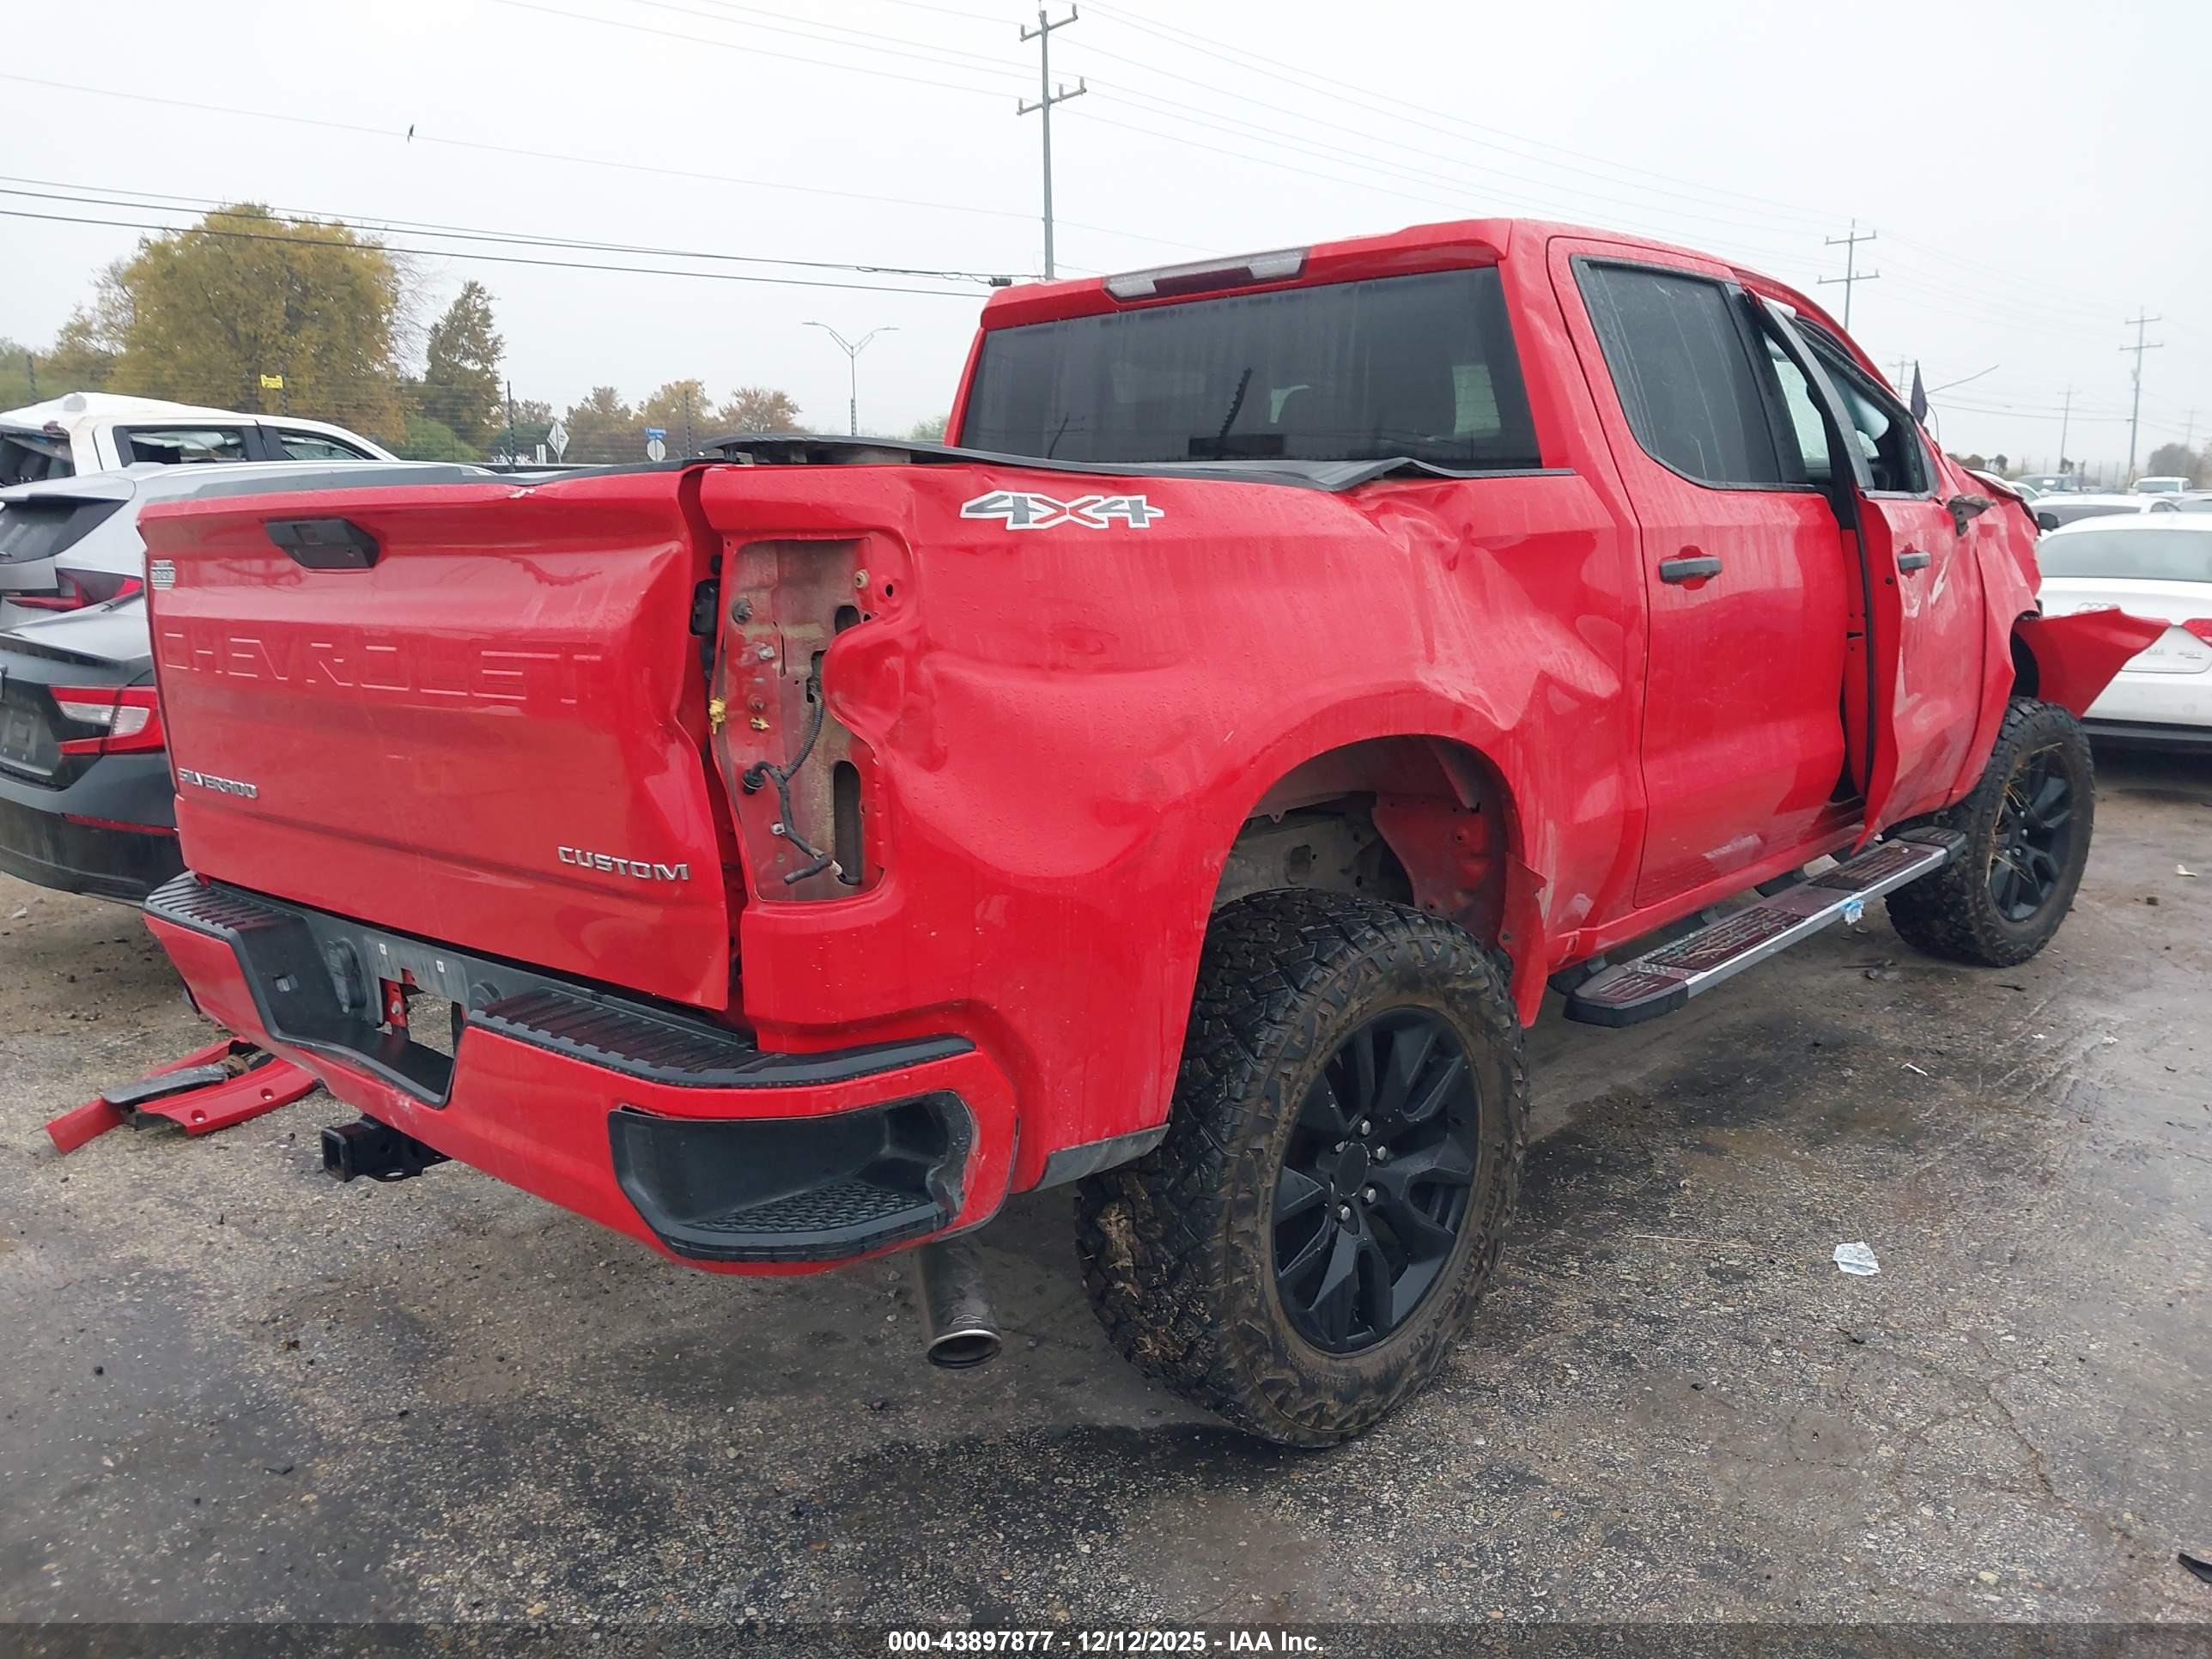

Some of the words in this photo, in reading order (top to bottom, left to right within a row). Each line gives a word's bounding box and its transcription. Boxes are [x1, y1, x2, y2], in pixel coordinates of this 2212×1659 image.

[164, 631, 603, 705] CHEVROLET
[178, 767, 258, 799] SILVERADO
[557, 845, 690, 881] CUSTOM
